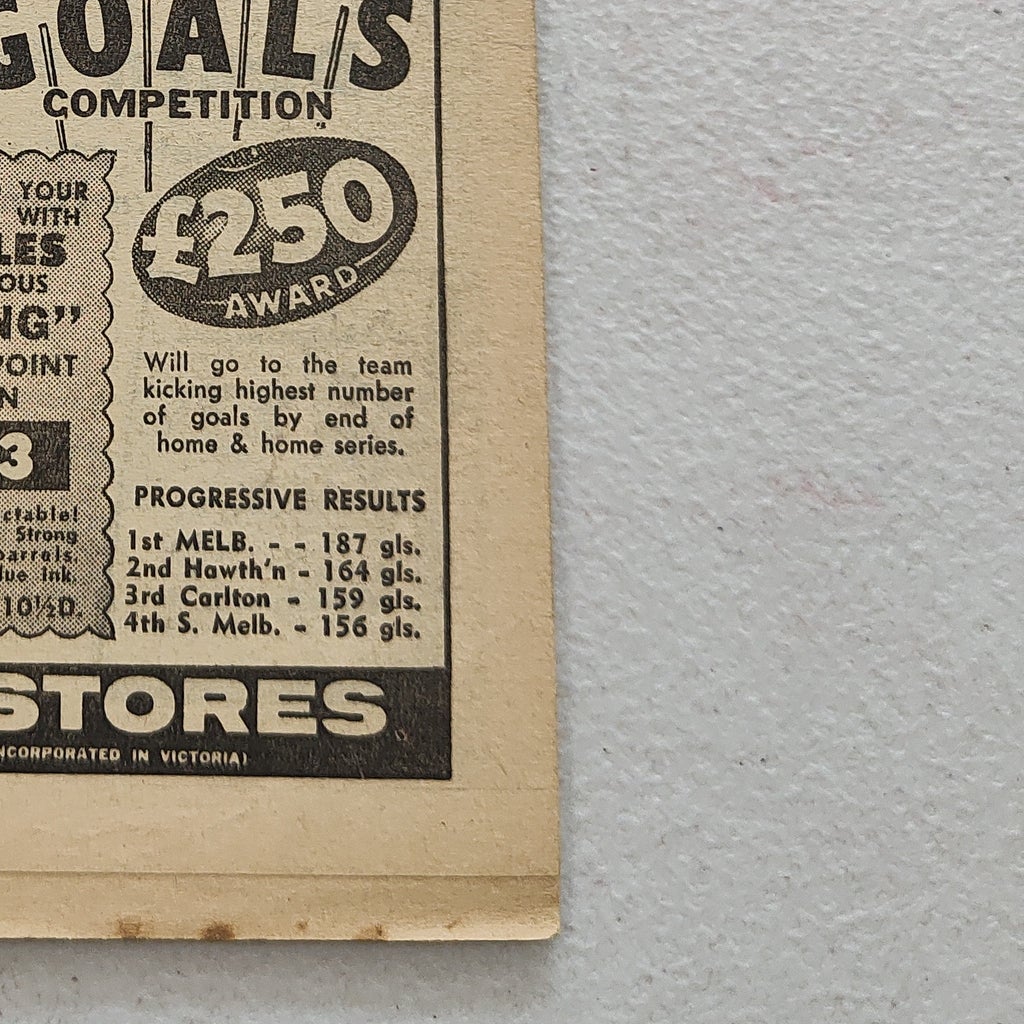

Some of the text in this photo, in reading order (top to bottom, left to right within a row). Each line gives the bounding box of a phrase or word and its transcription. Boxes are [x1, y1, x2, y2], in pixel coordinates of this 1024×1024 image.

[43, 88, 334, 120] COMPETITION
[19, 180, 89, 201] YOUR
[16, 206, 80, 226] WITH
[142, 157, 394, 285] £250
[225, 265, 359, 319] AWARD
[143, 351, 412, 376] Will go to the team
[143, 377, 414, 404] kicking highest number
[143, 405, 414, 432] of goals by end of
[157, 431, 404, 456] home & home series.
[134, 486, 426, 512] PROGRESSIVE RESULTS
[16, 526, 77, 544] Strong
[128, 529, 422, 558] 1st MELB. 187 gls.
[126, 556, 422, 586] 2nd Hawth'n 164 gls.
[125, 584, 422, 613] 3rd Carlton 159 gls.
[124, 611, 421, 642] 4th S. Melb. 156 gls.
[132, 748, 149, 762] IN
[160, 749, 248, 765] VICTORIA)
